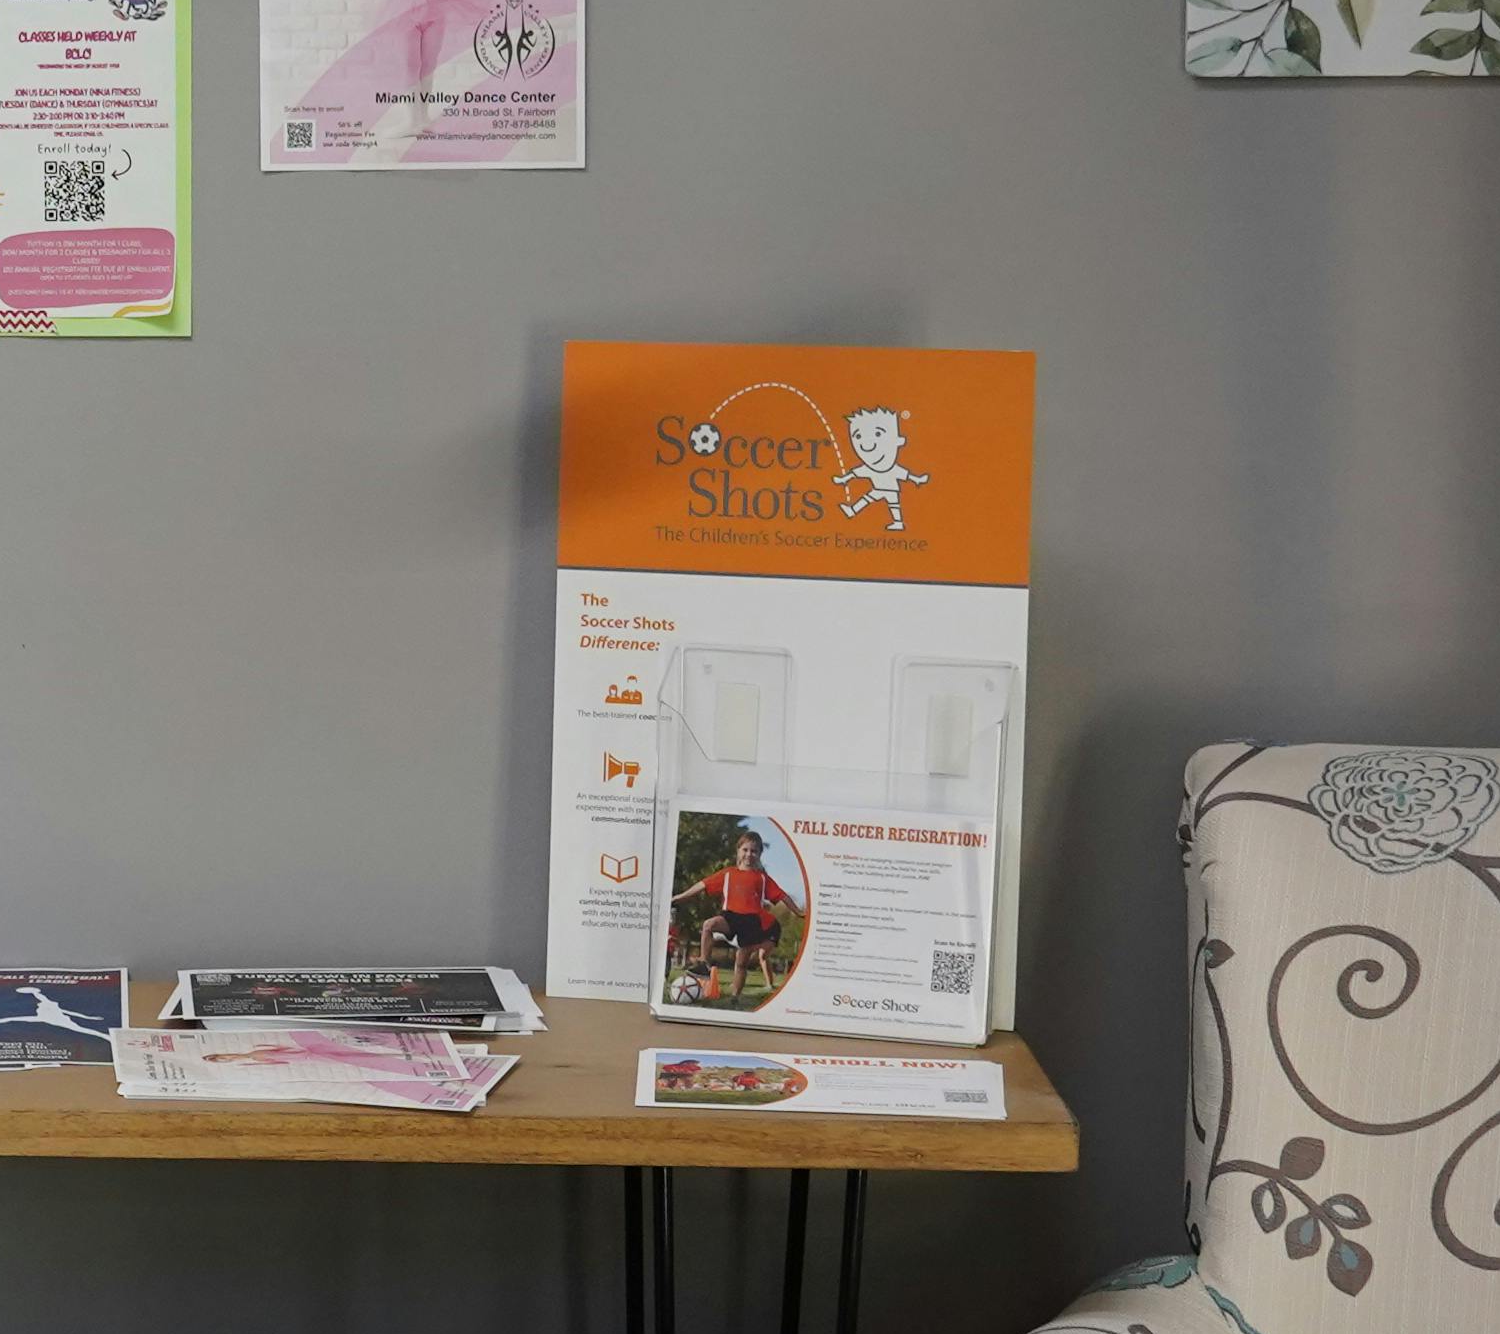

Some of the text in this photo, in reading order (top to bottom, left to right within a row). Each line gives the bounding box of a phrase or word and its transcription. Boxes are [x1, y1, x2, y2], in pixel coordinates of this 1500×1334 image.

[18, 30, 137, 43] CLASSES HELD WEEKLY AT
[480, 47, 505, 76] DANCE
[59, 87, 88, 97] MONDAY
[375, 91, 556, 106] Miami Valley Dance Center
[66, 99, 101, 109] THURSDAY
[443, 108, 556, 117] 330 Fairborn
[38, 142, 112, 158] Enroll today!
[655, 416, 833, 471] Soccer
[687, 467, 825, 523] Shots
[655, 525, 929, 552] The Children's Soccer Experience
[580, 593, 609, 607] The
[580, 614, 675, 632] Soccer Shots
[579, 635, 661, 652] Difference:
[578, 709, 637, 721] The best-trained
[591, 816, 651, 825] communication
[793, 820, 988, 849] FALL SOCCER REGISRATION!
[28, 973, 111, 981] BASKETBALL
[832, 994, 919, 1014] Soccer Shots
[793, 1057, 968, 1069] ENROLL NOW!
